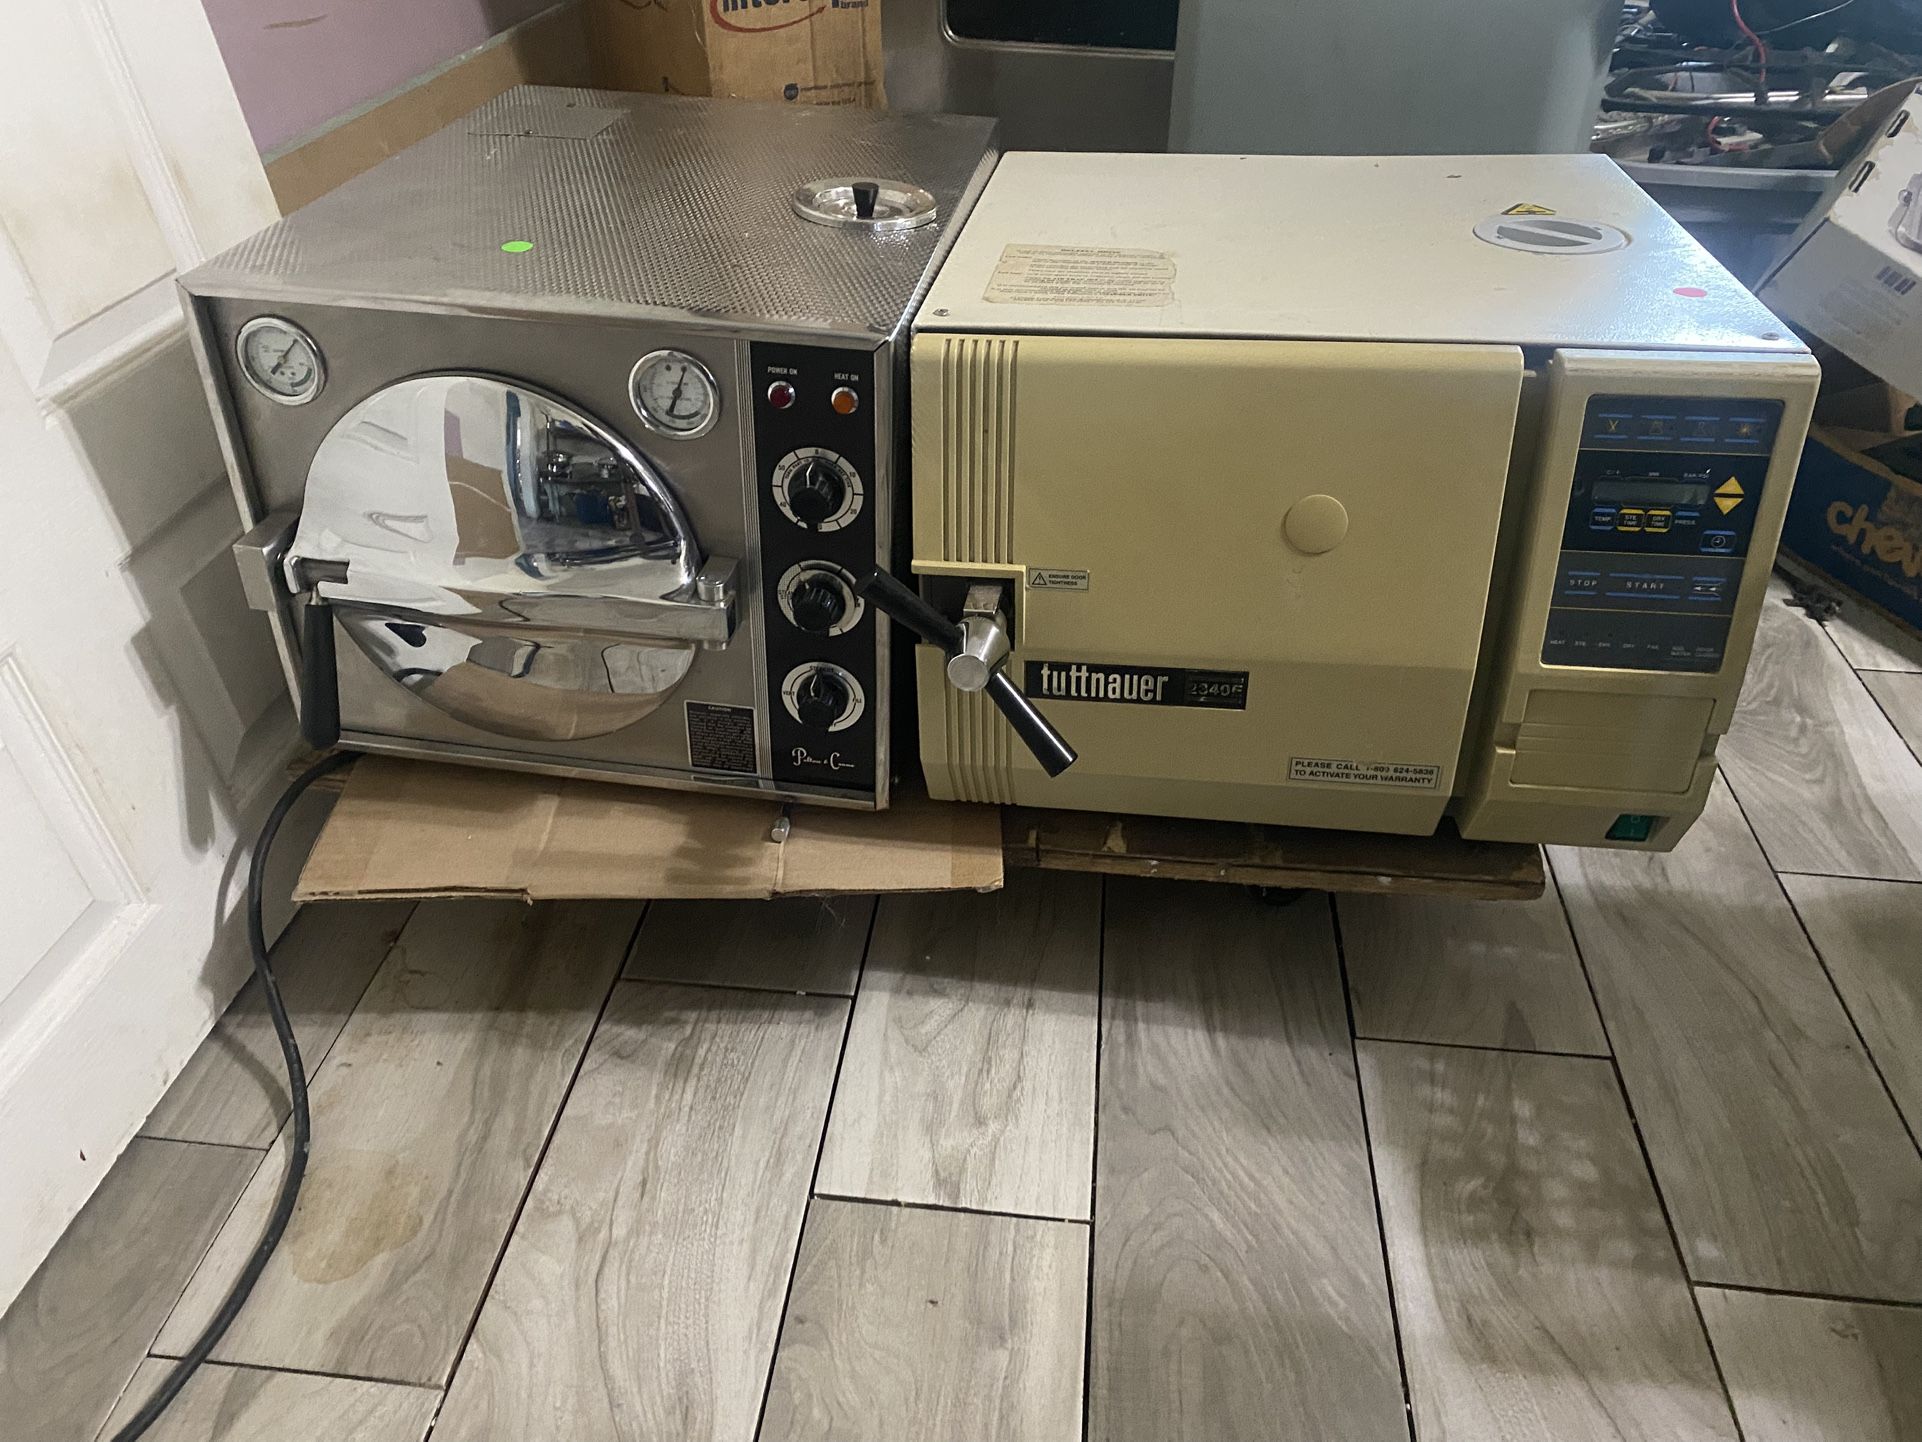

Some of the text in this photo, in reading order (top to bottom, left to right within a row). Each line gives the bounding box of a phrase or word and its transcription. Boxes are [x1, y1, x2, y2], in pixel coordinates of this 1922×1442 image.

[767, 366, 787, 375] POWER
[849, 471, 857, 479] 10
[1569, 579, 1598, 587] STOP
[1626, 581, 1666, 591] START
[1041, 663, 1169, 701] tuttnauer
[1295, 760, 1332, 770] PLEASE
[1336, 763, 1360, 771] CALL
[1294, 769, 1433, 785] TO ACTIVATE YOUR WARRANTY
